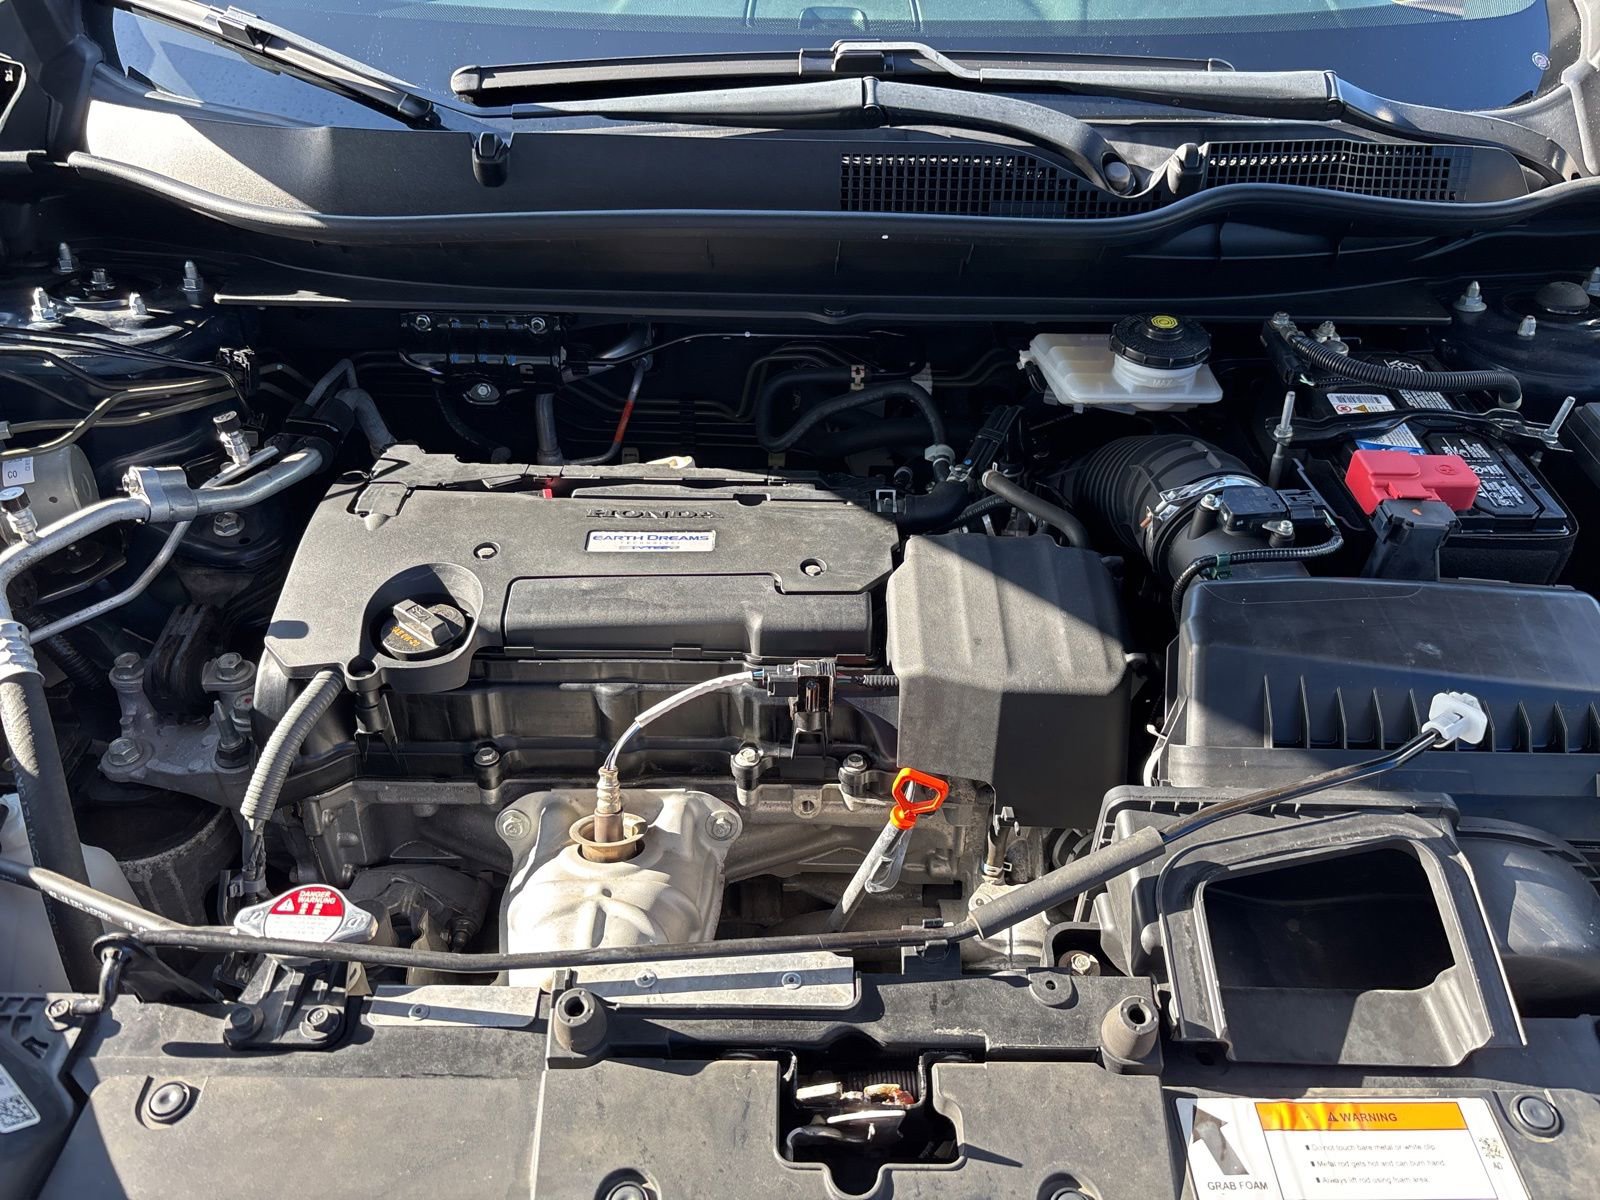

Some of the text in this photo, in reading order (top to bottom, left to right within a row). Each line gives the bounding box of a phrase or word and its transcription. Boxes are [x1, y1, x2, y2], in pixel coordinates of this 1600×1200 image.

[586, 508, 724, 519] HONDA
[299, 890, 332, 899] DANGER
[1339, 1112, 1398, 1123] WARNING
[1356, 1143, 1373, 1151] bare
[1374, 1143, 1393, 1151] metal
[1351, 1160, 1367, 1168] gets
[1322, 1176, 1348, 1185] Always
[1359, 1176, 1371, 1184] rod
[1372, 1176, 1392, 1185] using
[1392, 1176, 1411, 1184] foam
[1207, 1181, 1268, 1190] GRAB FOAM
